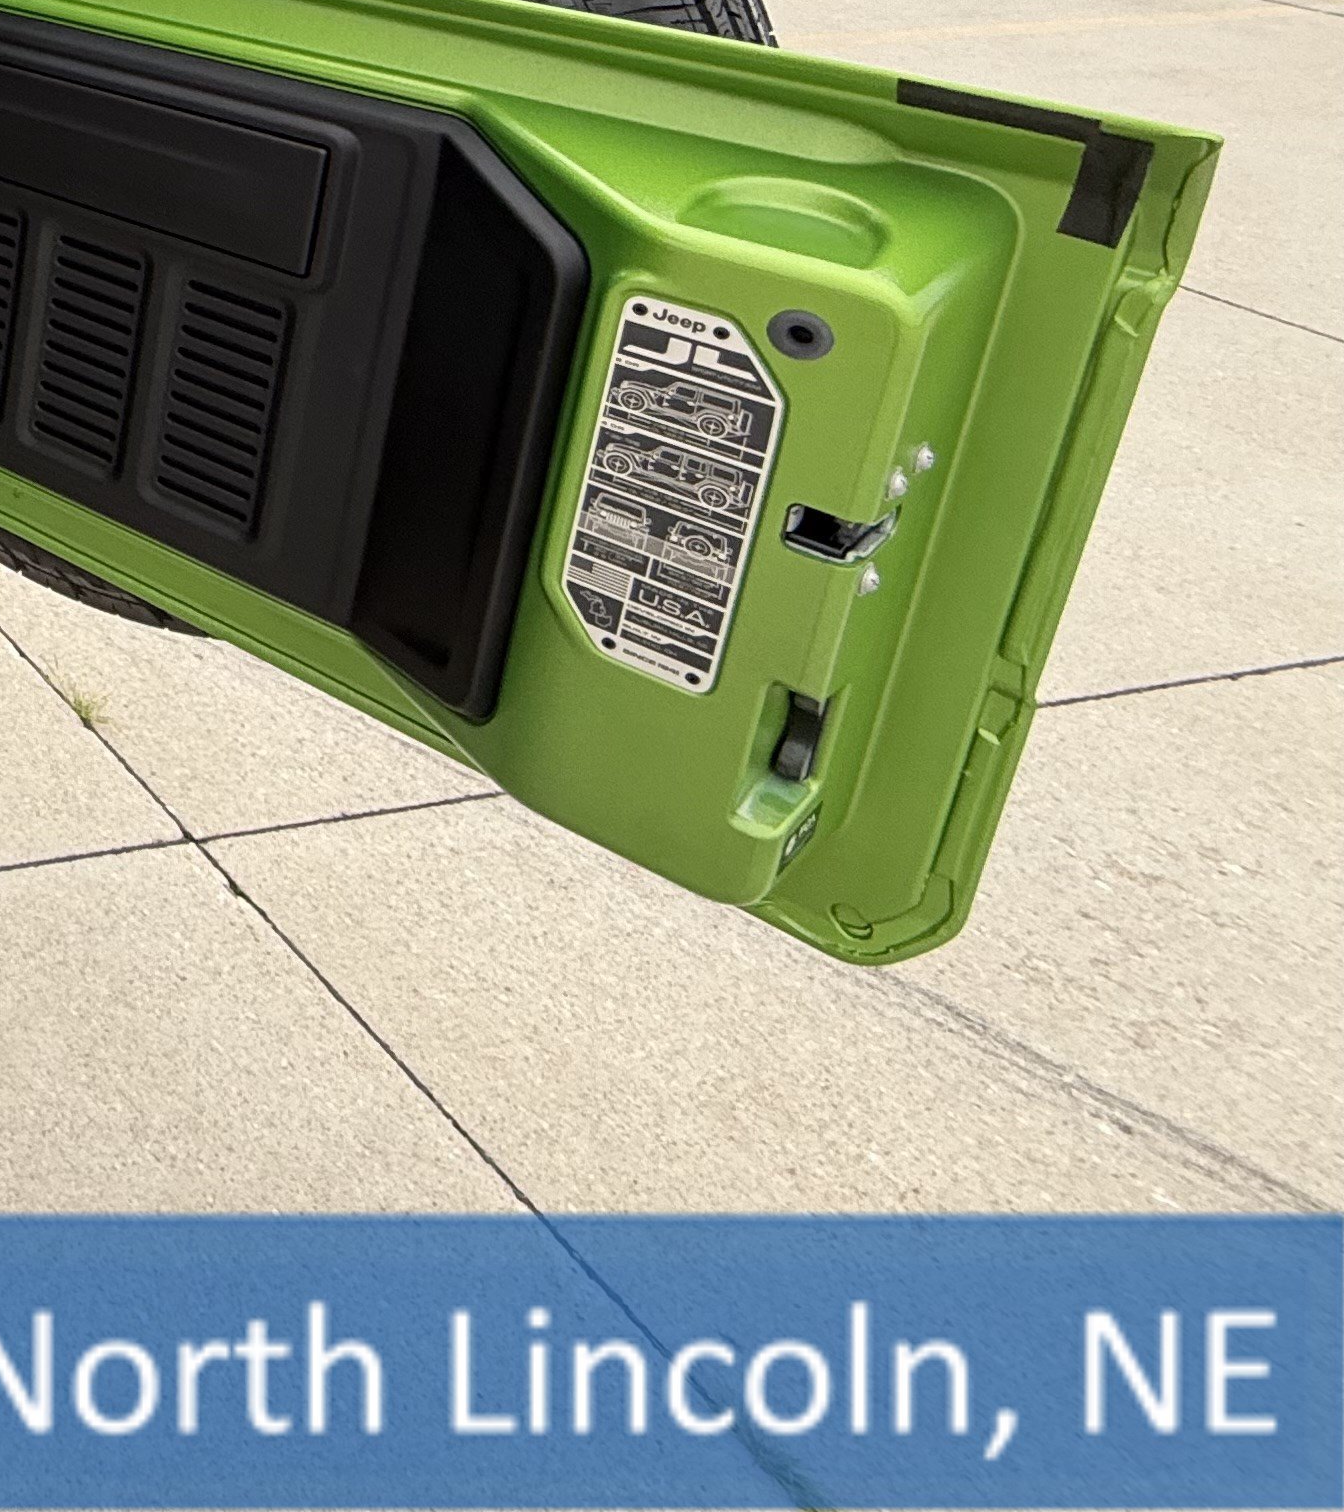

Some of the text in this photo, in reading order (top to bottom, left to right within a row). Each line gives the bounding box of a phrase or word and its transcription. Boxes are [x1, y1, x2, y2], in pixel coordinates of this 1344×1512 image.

[652, 308, 707, 334] Jeep
[638, 588, 711, 629] U.S.A.
[622, 647, 657, 667] SINCE
